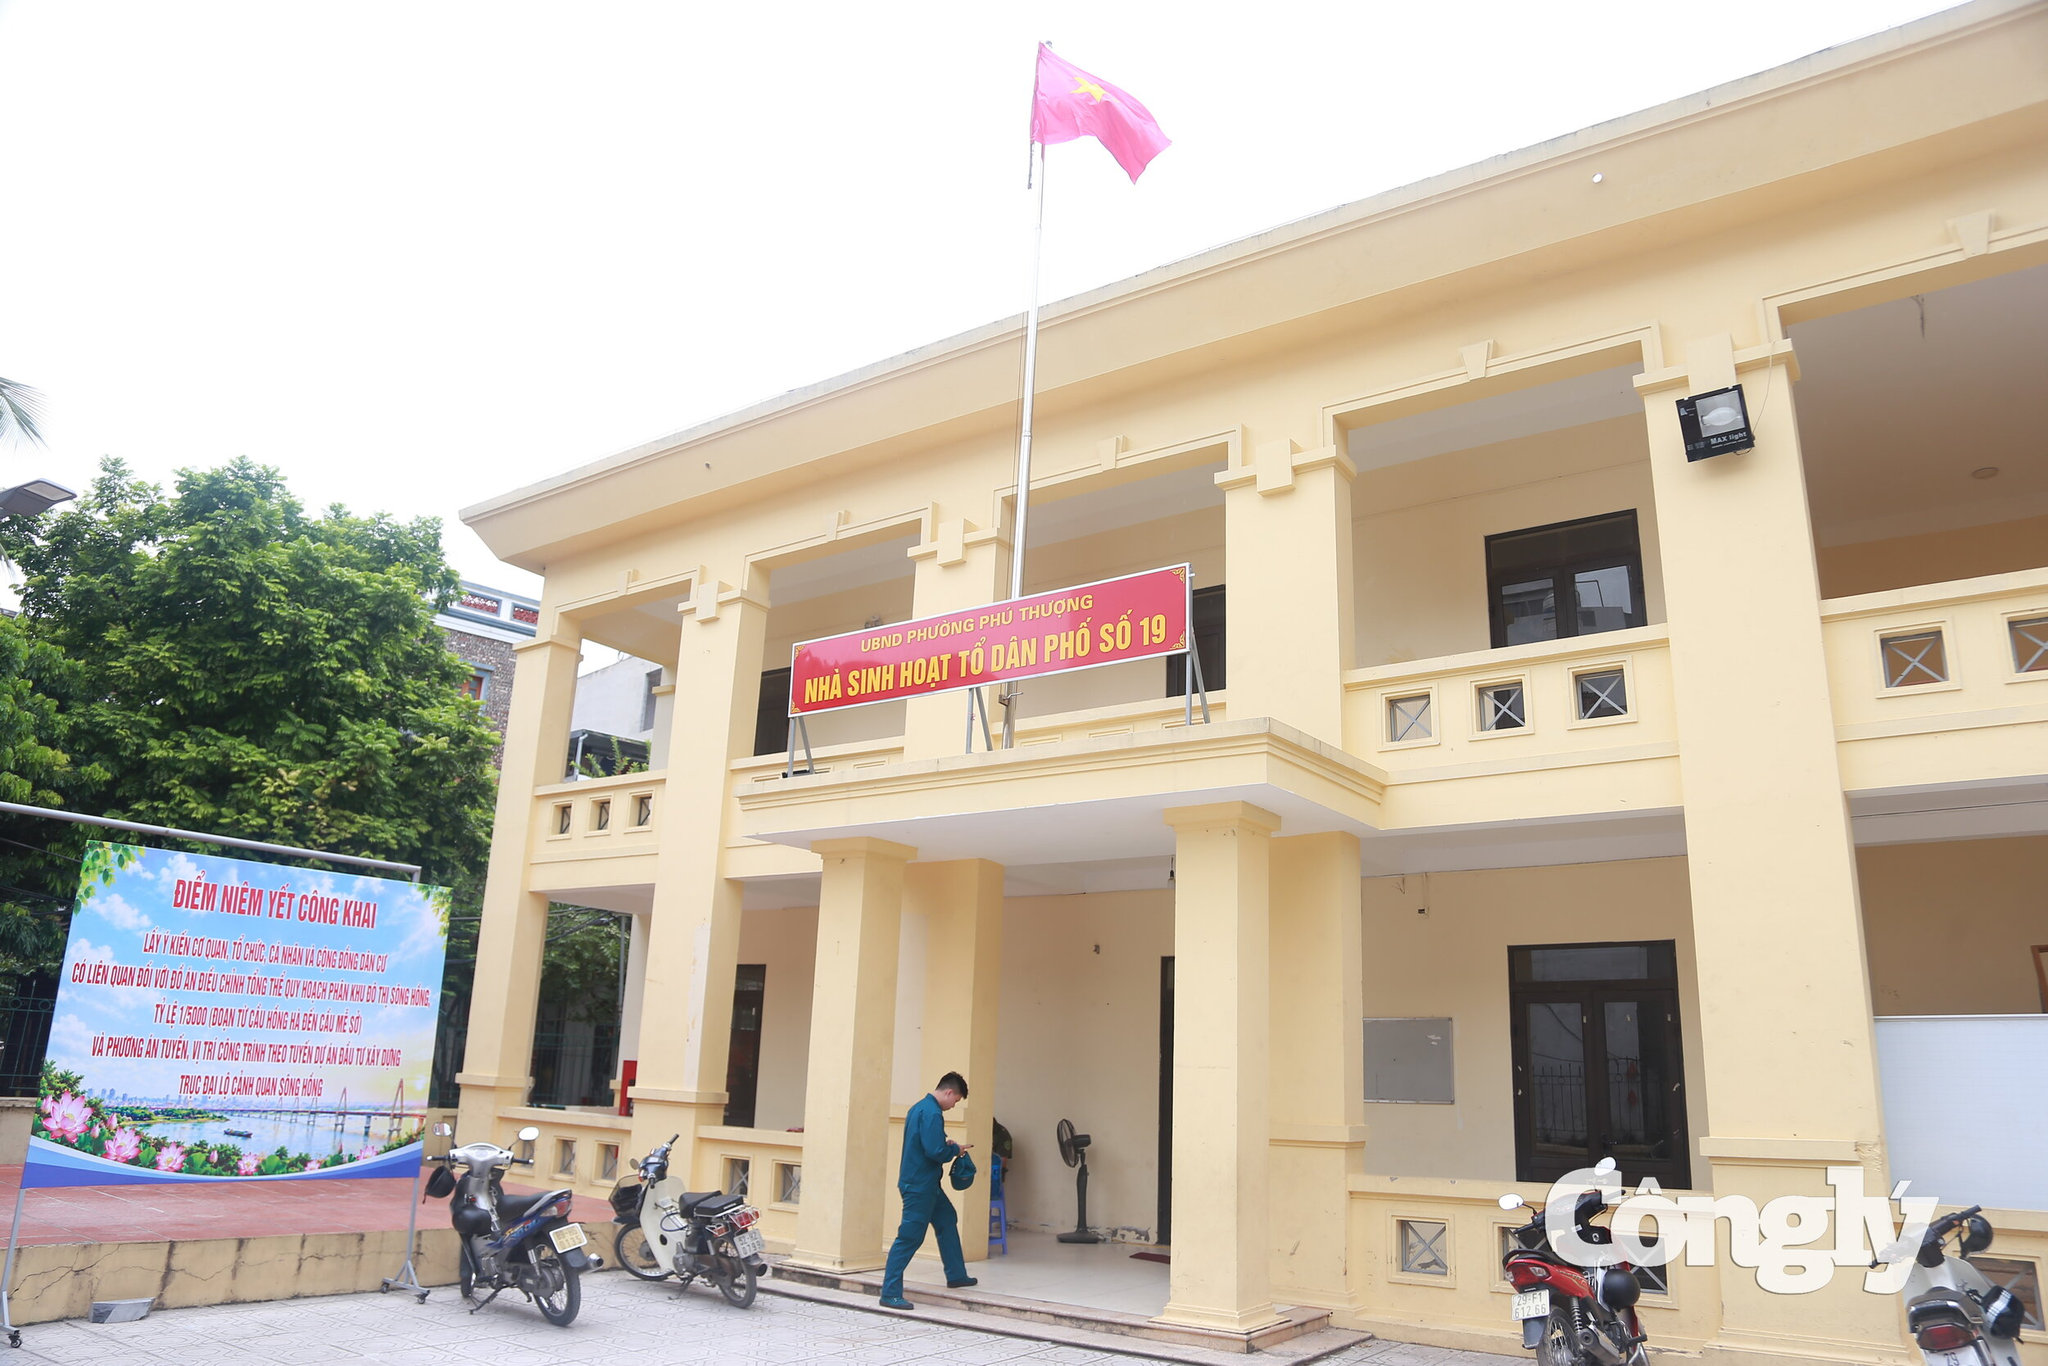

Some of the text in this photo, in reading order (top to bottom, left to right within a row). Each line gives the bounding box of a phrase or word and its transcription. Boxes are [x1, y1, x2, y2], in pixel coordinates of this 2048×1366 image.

[1710, 436, 1728, 444] MAX
[1729, 431, 1747, 440] light
[861, 594, 1094, 653] UBND PHƯỜNG PHÚ THƯỢNG
[804, 608, 1167, 704] NHÀ SINH HOẠT TỔ DÂN PHỐ SỐ 19
[173, 870, 378, 929] ĐIỂM NIÊM YẾT CÔNG KHAI
[1517, 1292, 1542, 1307] 29-F1
